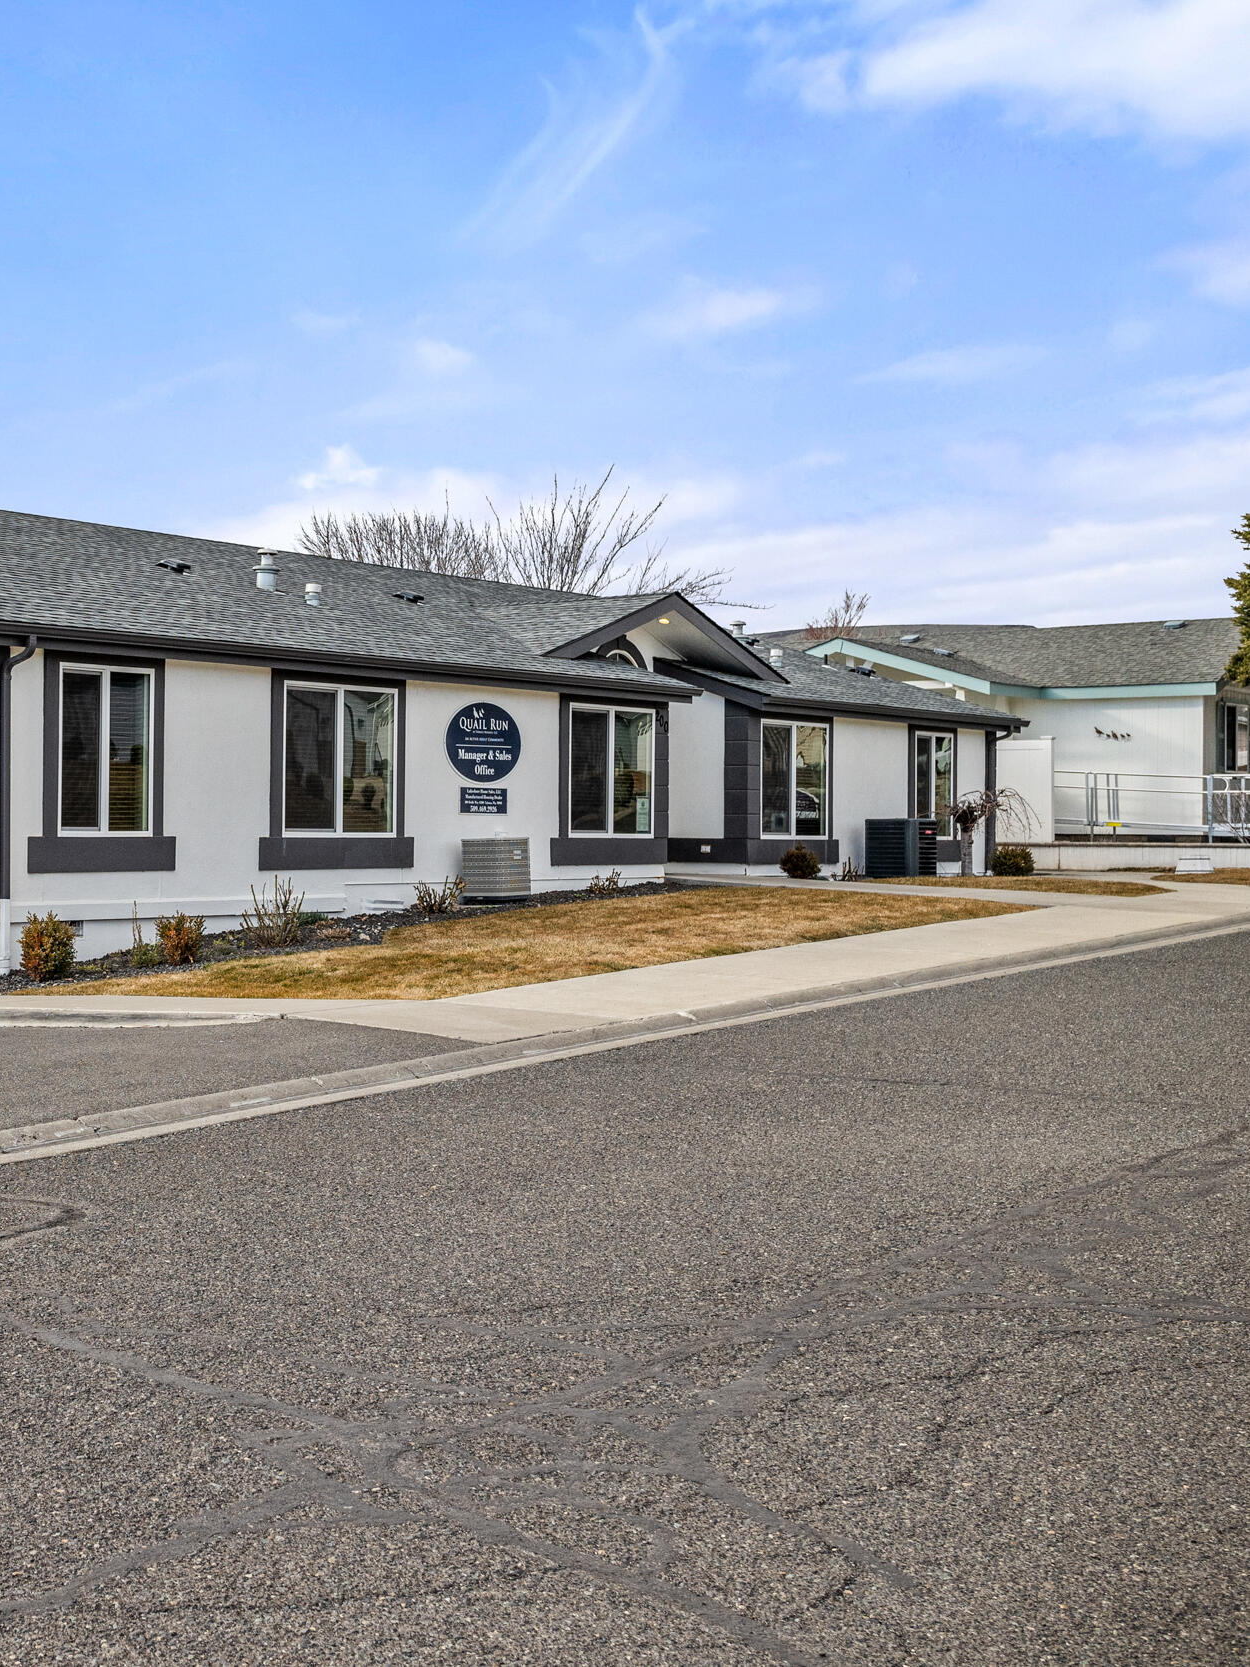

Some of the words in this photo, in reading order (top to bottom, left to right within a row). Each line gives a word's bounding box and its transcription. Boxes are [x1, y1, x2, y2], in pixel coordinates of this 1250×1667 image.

[459, 716, 488, 732] QUAIL
[490, 718, 509, 731] RUN
[655, 710, 669, 733] 200
[458, 749, 487, 763] Manager
[488, 750, 494, 760] &
[495, 750, 512, 761] Sales
[474, 764, 495, 775] Office
